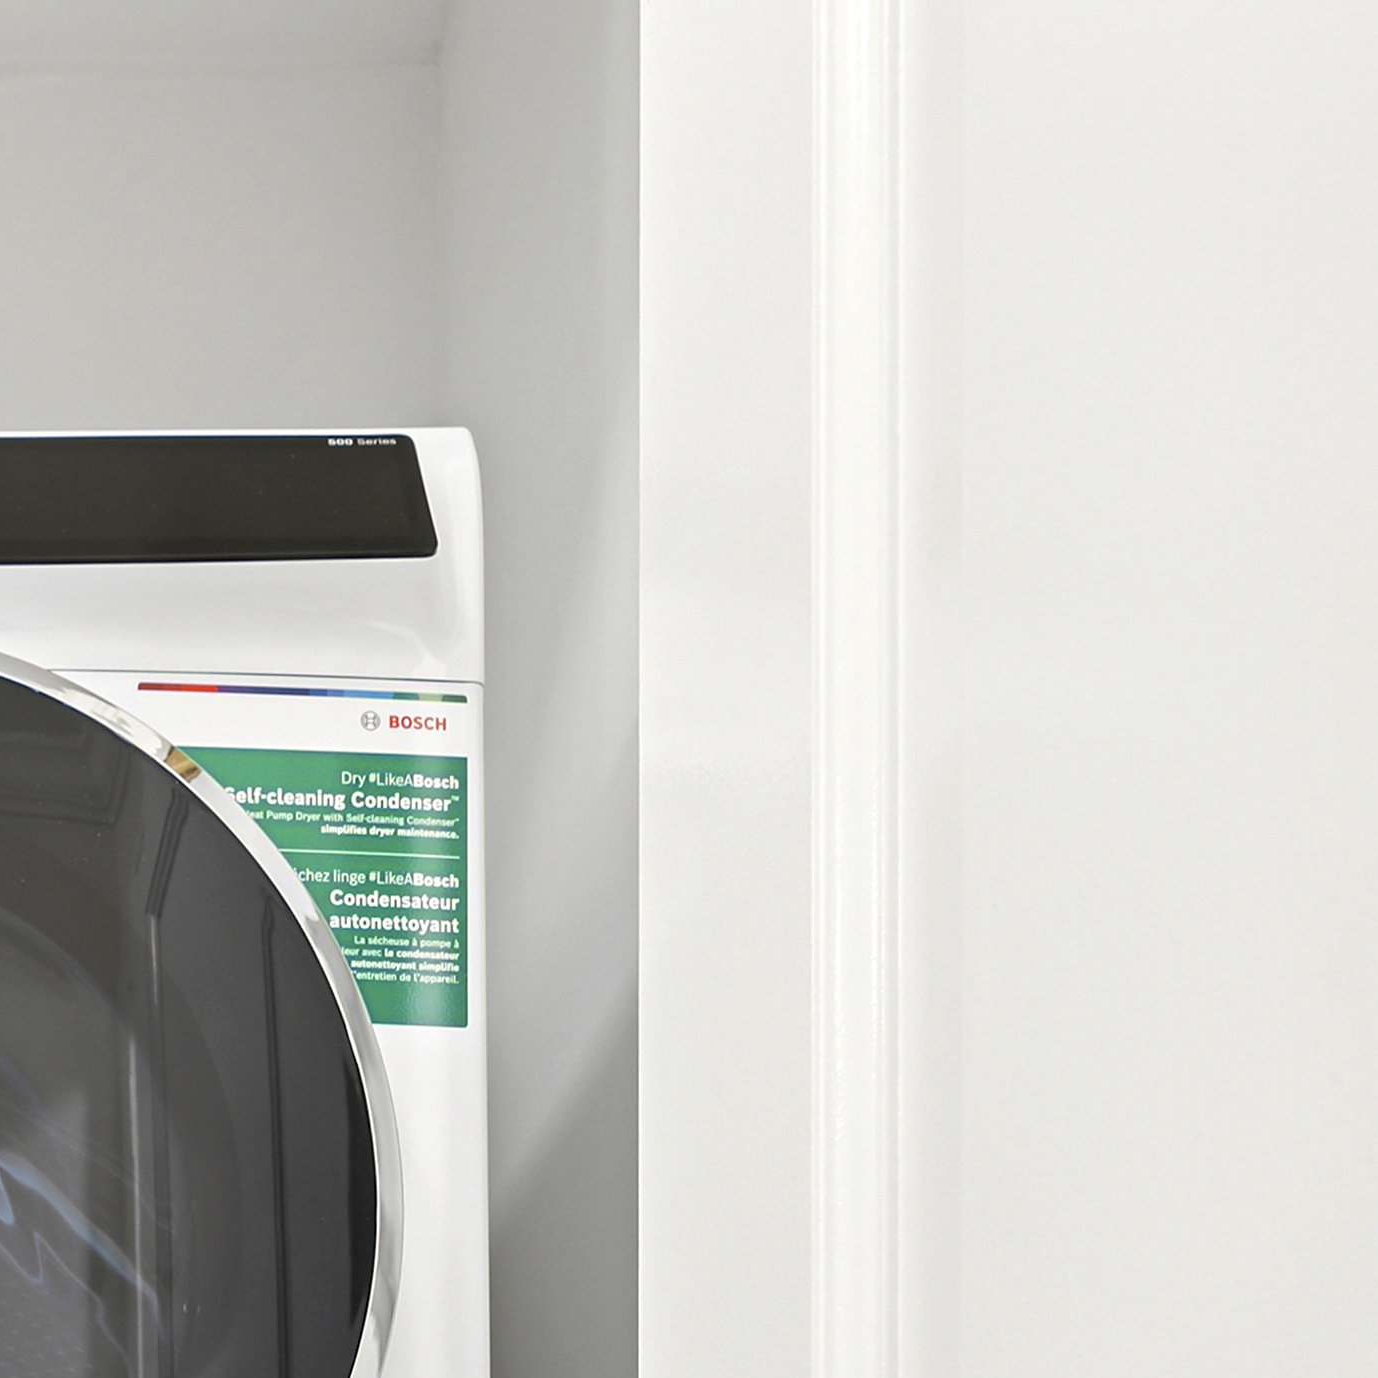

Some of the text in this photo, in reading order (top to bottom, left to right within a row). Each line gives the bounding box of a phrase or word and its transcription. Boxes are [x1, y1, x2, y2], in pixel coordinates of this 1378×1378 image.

[389, 716, 446, 730] BOSCH
[341, 772, 459, 789] Dry #LikeABosch
[249, 811, 263, 822] eat
[321, 826, 459, 839] simplifies dryer maintenance.
[294, 869, 459, 887] chez linge #LikeABosch
[330, 891, 460, 910] Condensateur
[330, 916, 459, 933] autonettoyant
[353, 971, 399, 981] 'entretien
